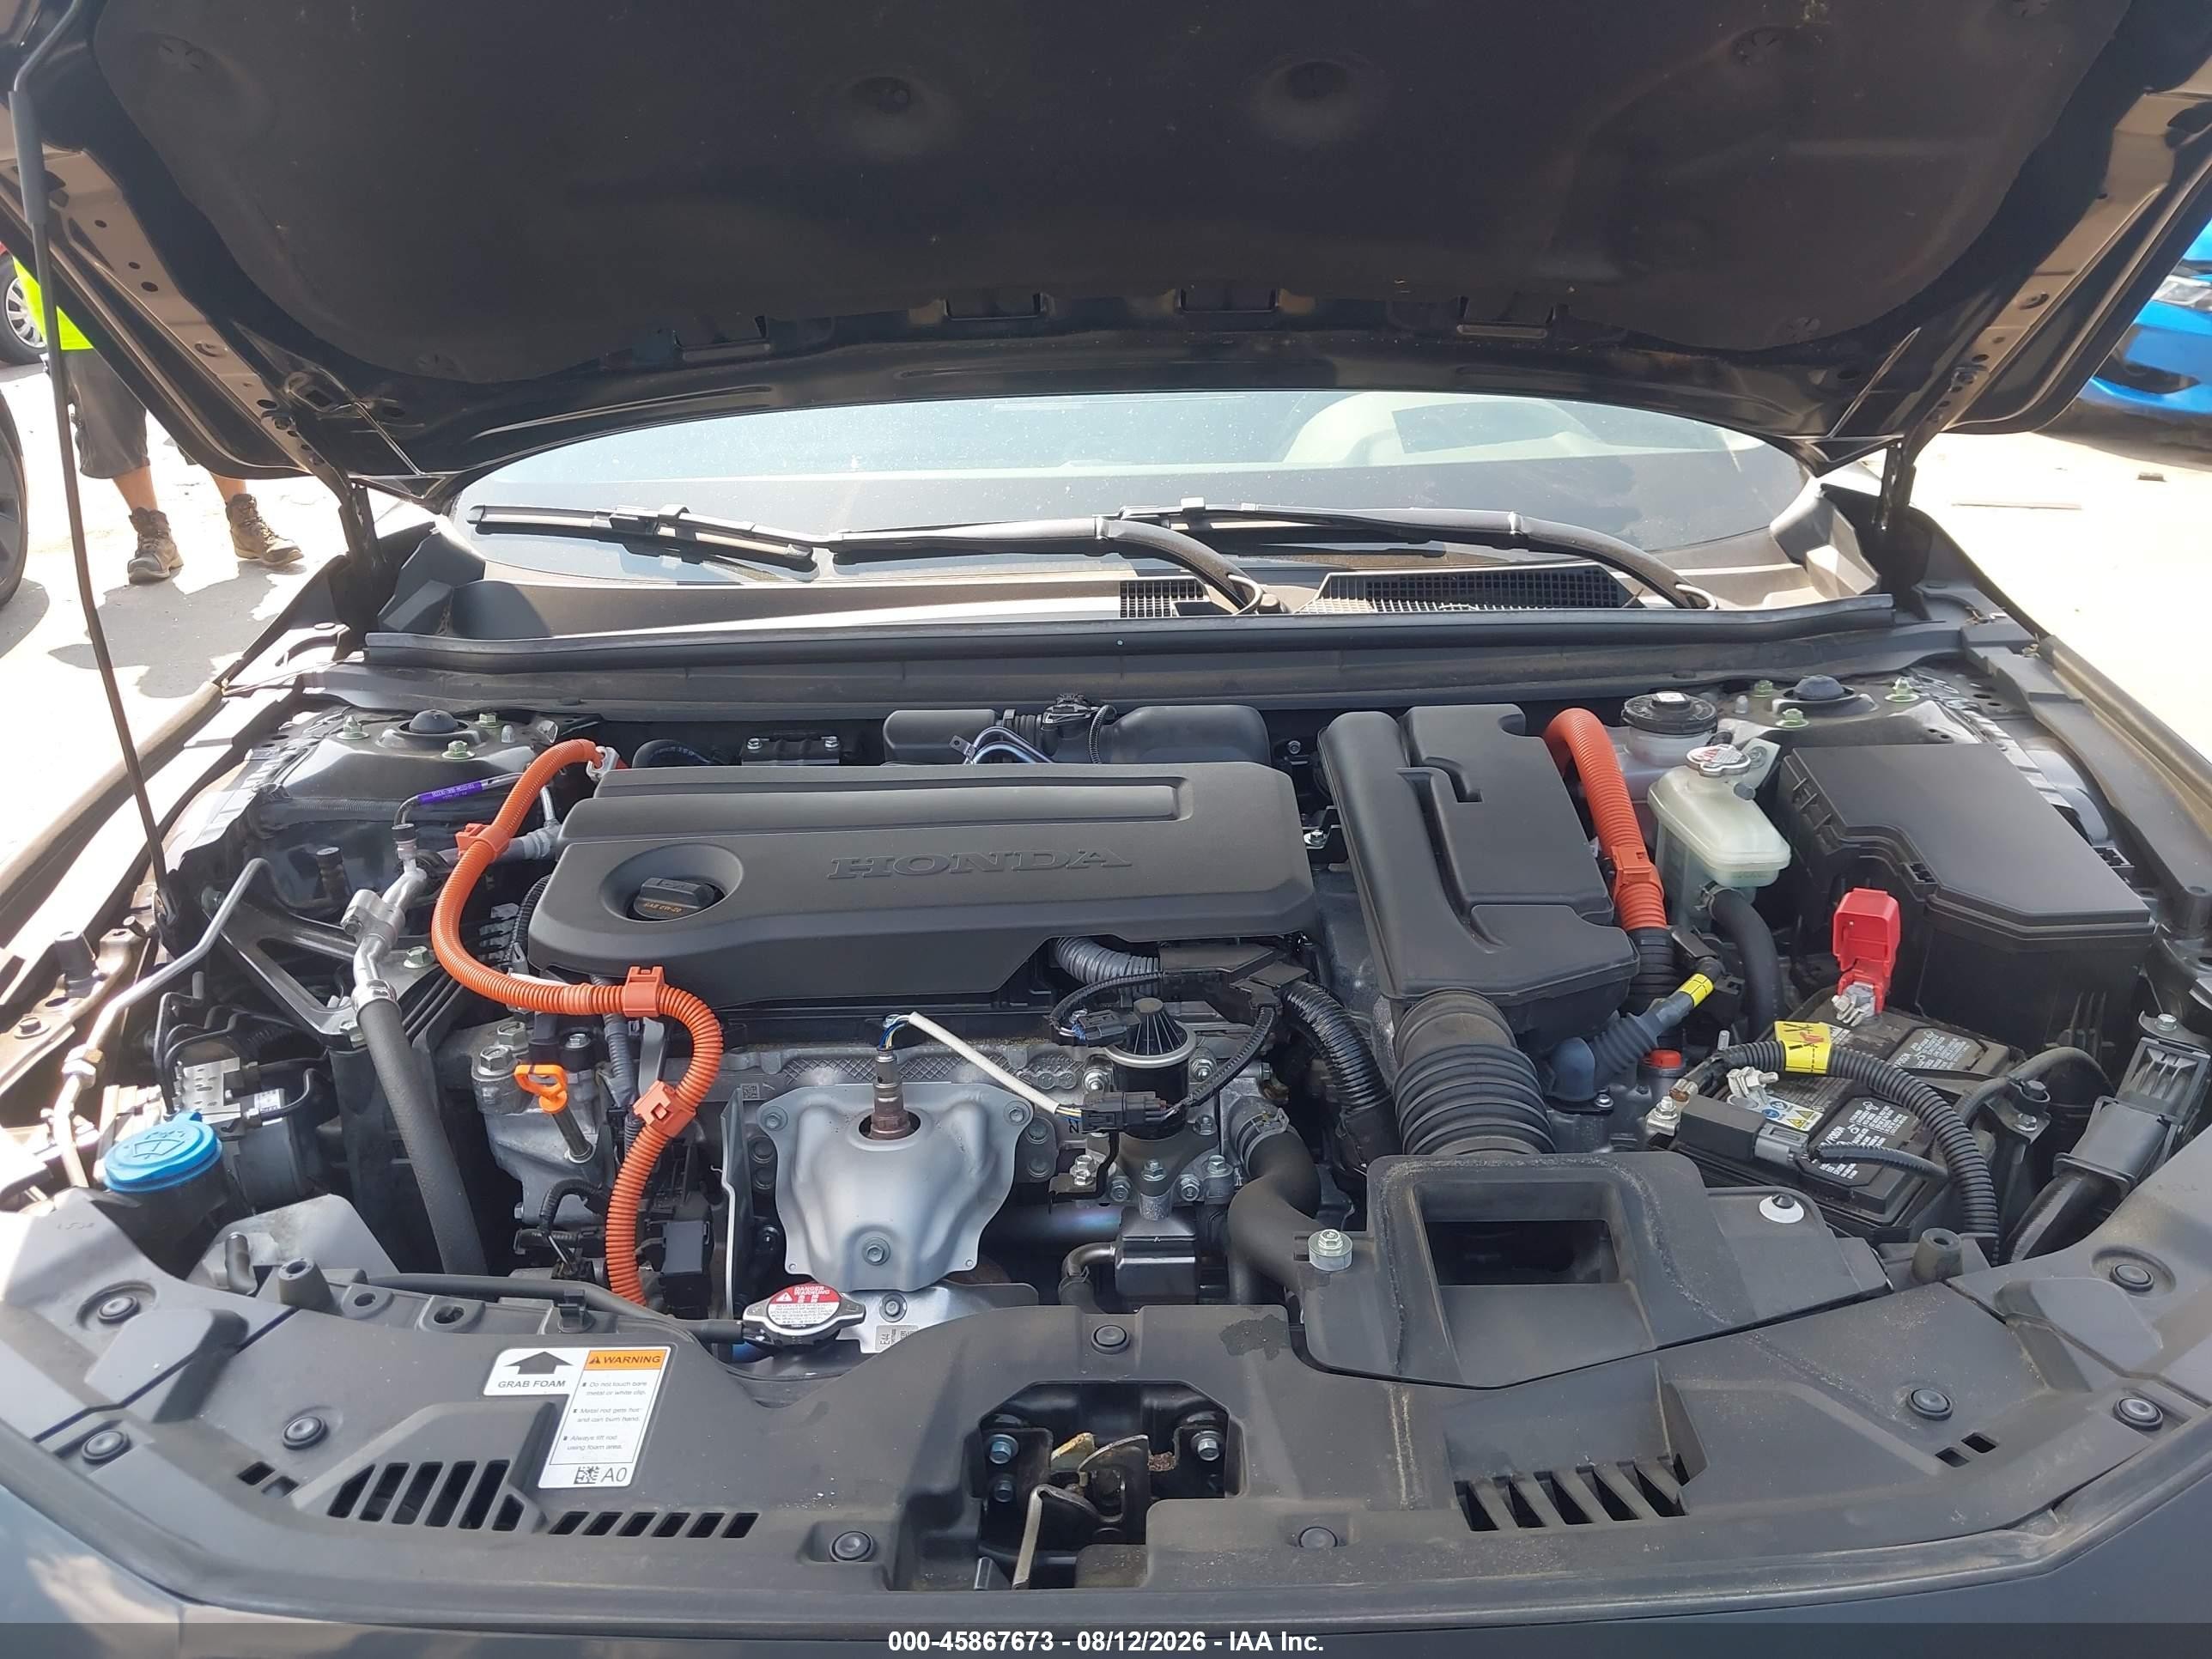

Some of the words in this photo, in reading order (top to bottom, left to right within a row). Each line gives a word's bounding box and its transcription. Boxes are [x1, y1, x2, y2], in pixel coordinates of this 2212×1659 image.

[827, 847, 1133, 880] HONDA
[604, 1355, 662, 1364] WARNING
[497, 1380, 531, 1389] GRAB
[532, 1379, 567, 1389] FOAM
[600, 1467, 628, 1483] A0
